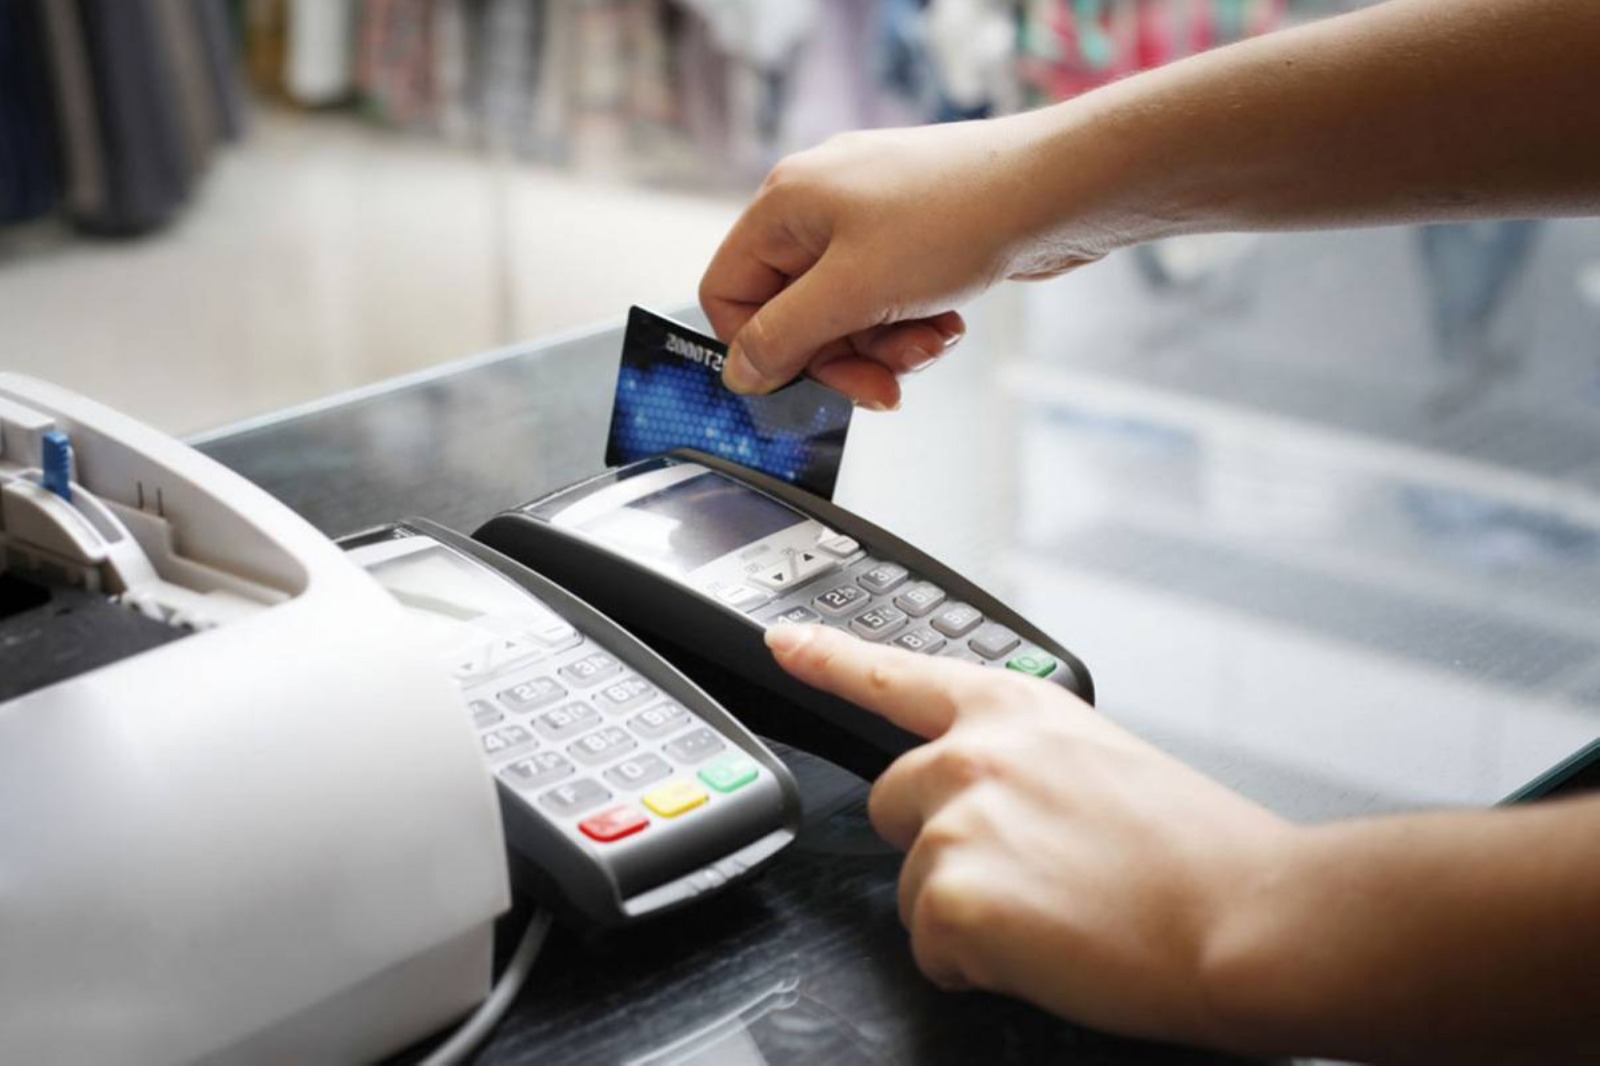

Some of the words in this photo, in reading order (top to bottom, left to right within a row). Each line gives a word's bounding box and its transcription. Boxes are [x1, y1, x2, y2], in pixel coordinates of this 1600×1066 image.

[870, 570, 889, 582] 3
[826, 592, 847, 605] 2
[907, 591, 927, 603] 6
[863, 613, 884, 627] 5
[902, 635, 923, 648] 8
[574, 661, 597, 675] 3
[514, 684, 537, 700] 2
[548, 710, 572, 726] 5
[486, 734, 506, 749] 4
[518, 759, 538, 775] 7
